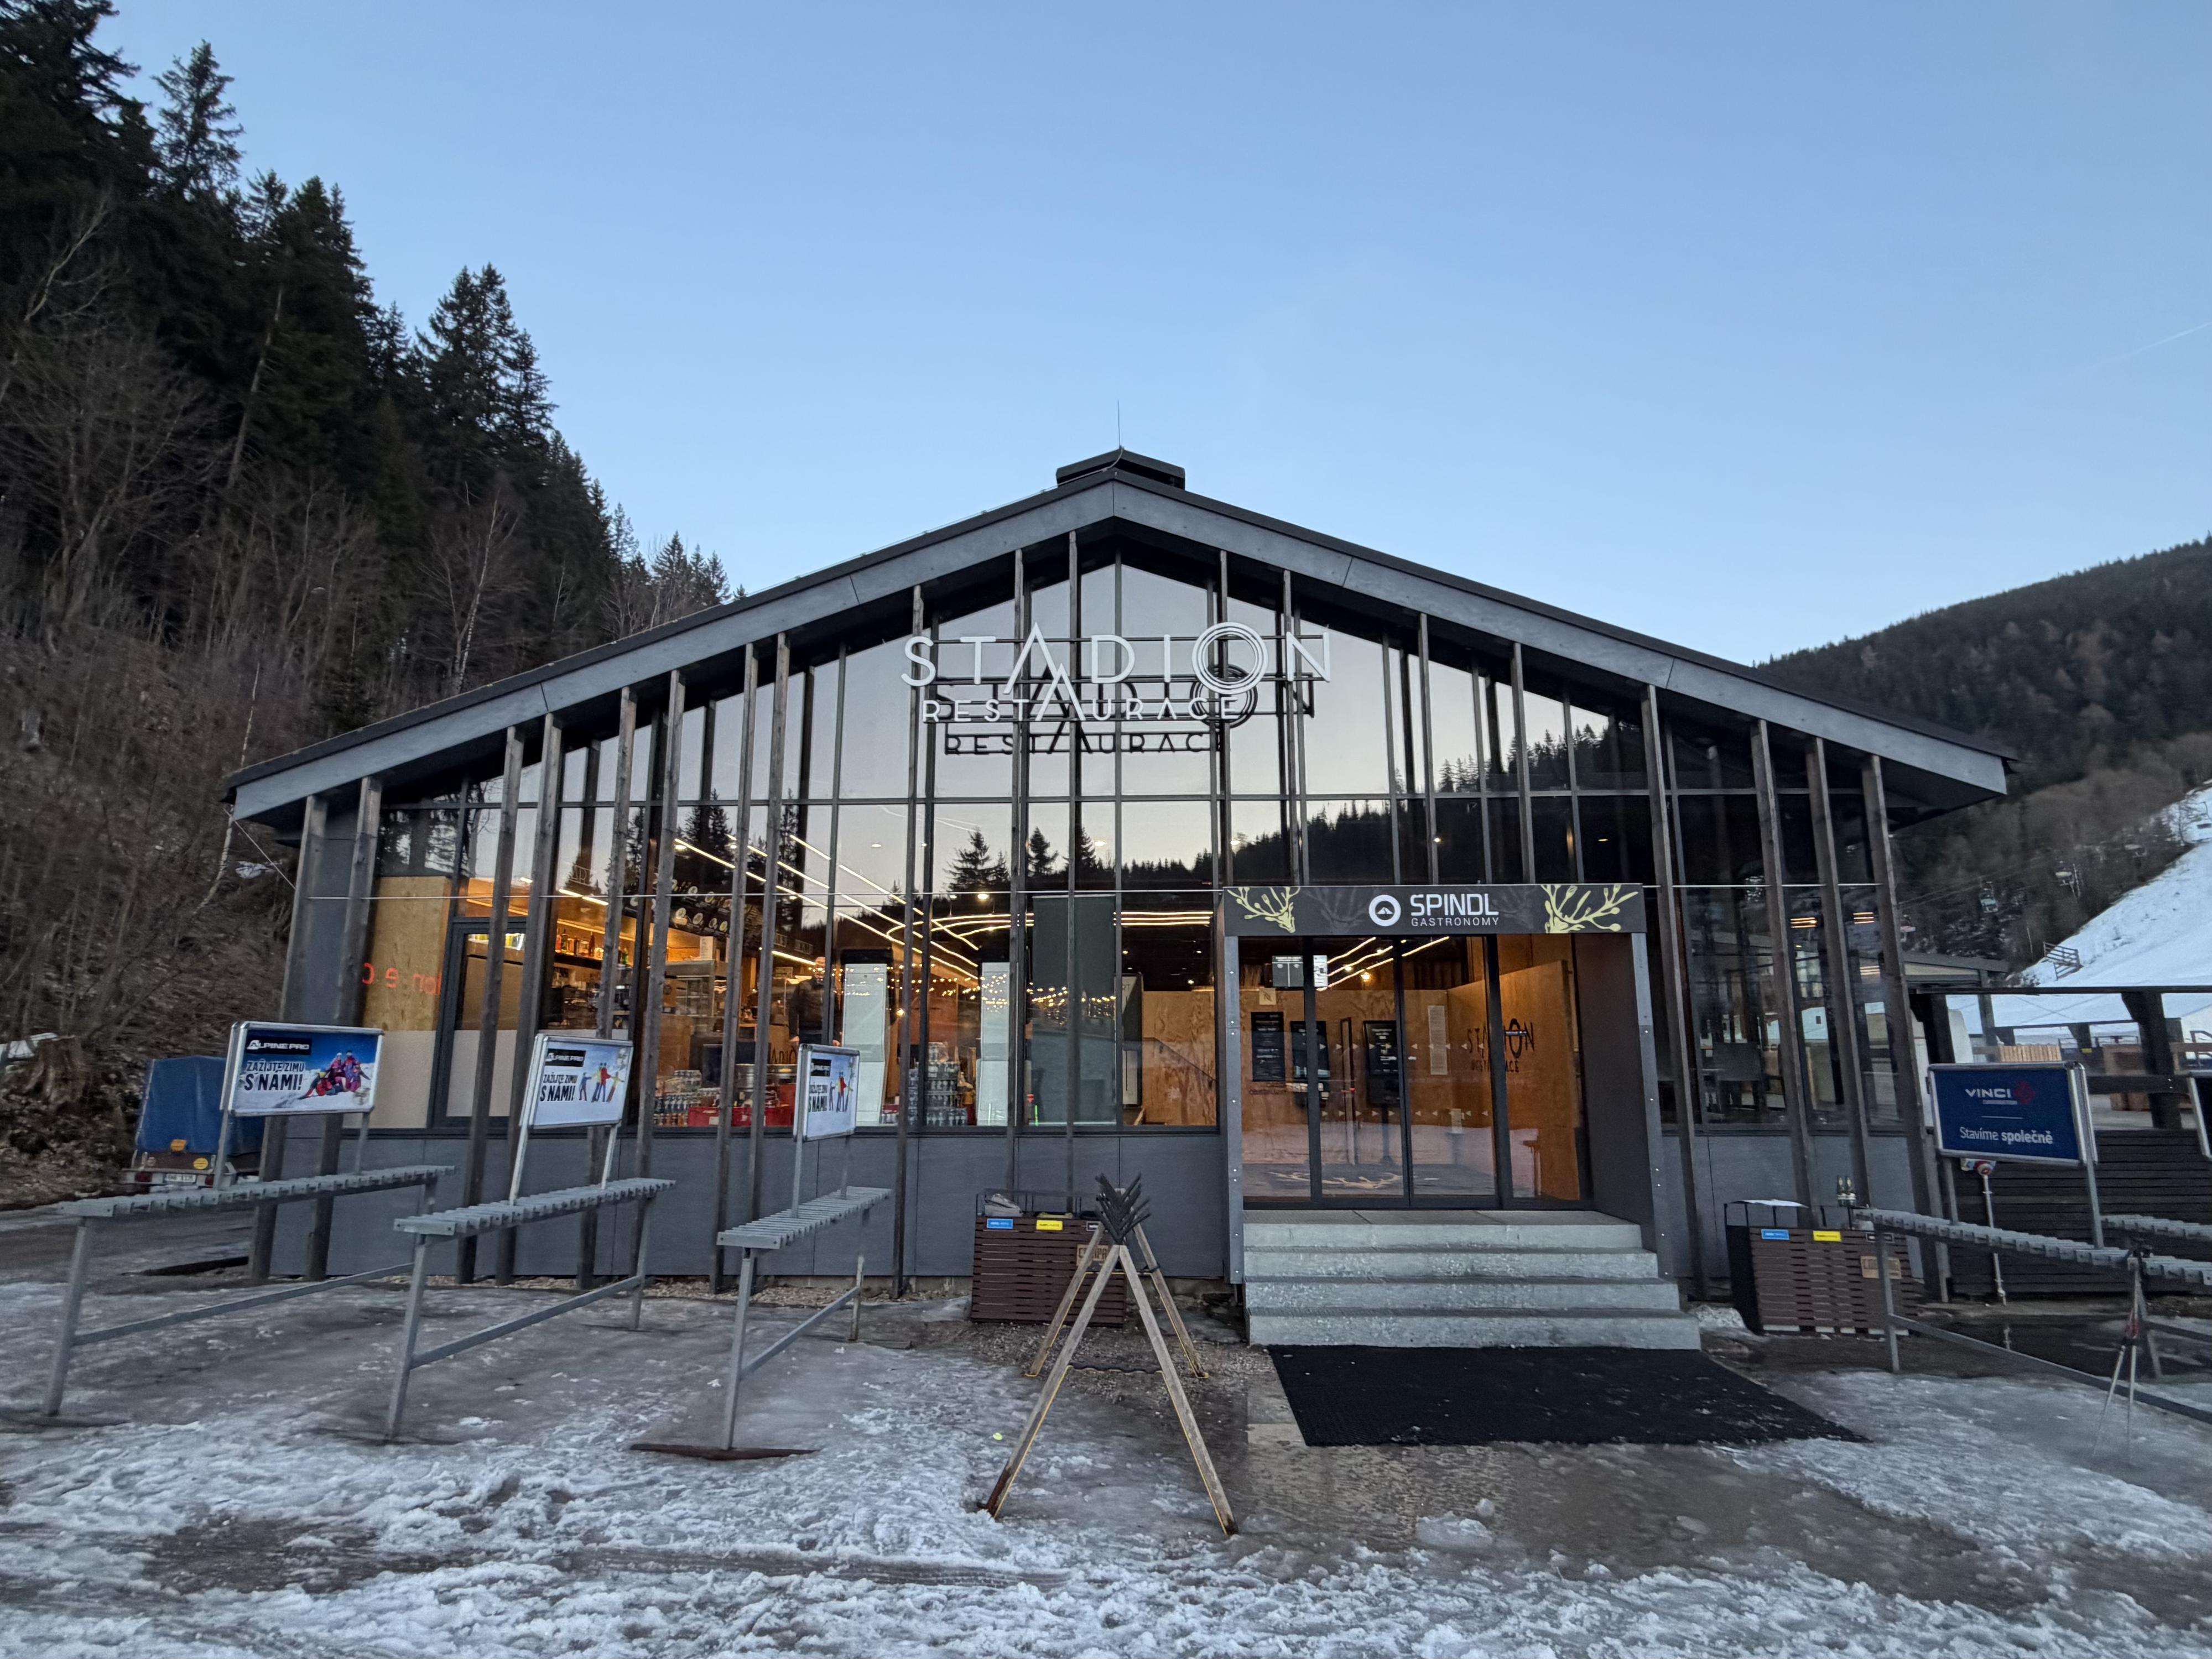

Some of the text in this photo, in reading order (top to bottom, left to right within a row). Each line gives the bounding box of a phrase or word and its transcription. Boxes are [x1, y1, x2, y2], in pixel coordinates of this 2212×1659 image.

[901, 621, 1331, 696] STADION
[922, 663, 1241, 722] RESTAURACE
[1410, 893, 1499, 916] SPINDL
[1411, 917, 1499, 926] GASTRONOMY
[247, 1040, 288, 1050] ALPINE
[244, 1073, 254, 1091] S
[540, 1085, 547, 1102] S
[1965, 1088, 2011, 1098] VINCI
[1960, 1126, 2053, 1145] Stavíme společně
